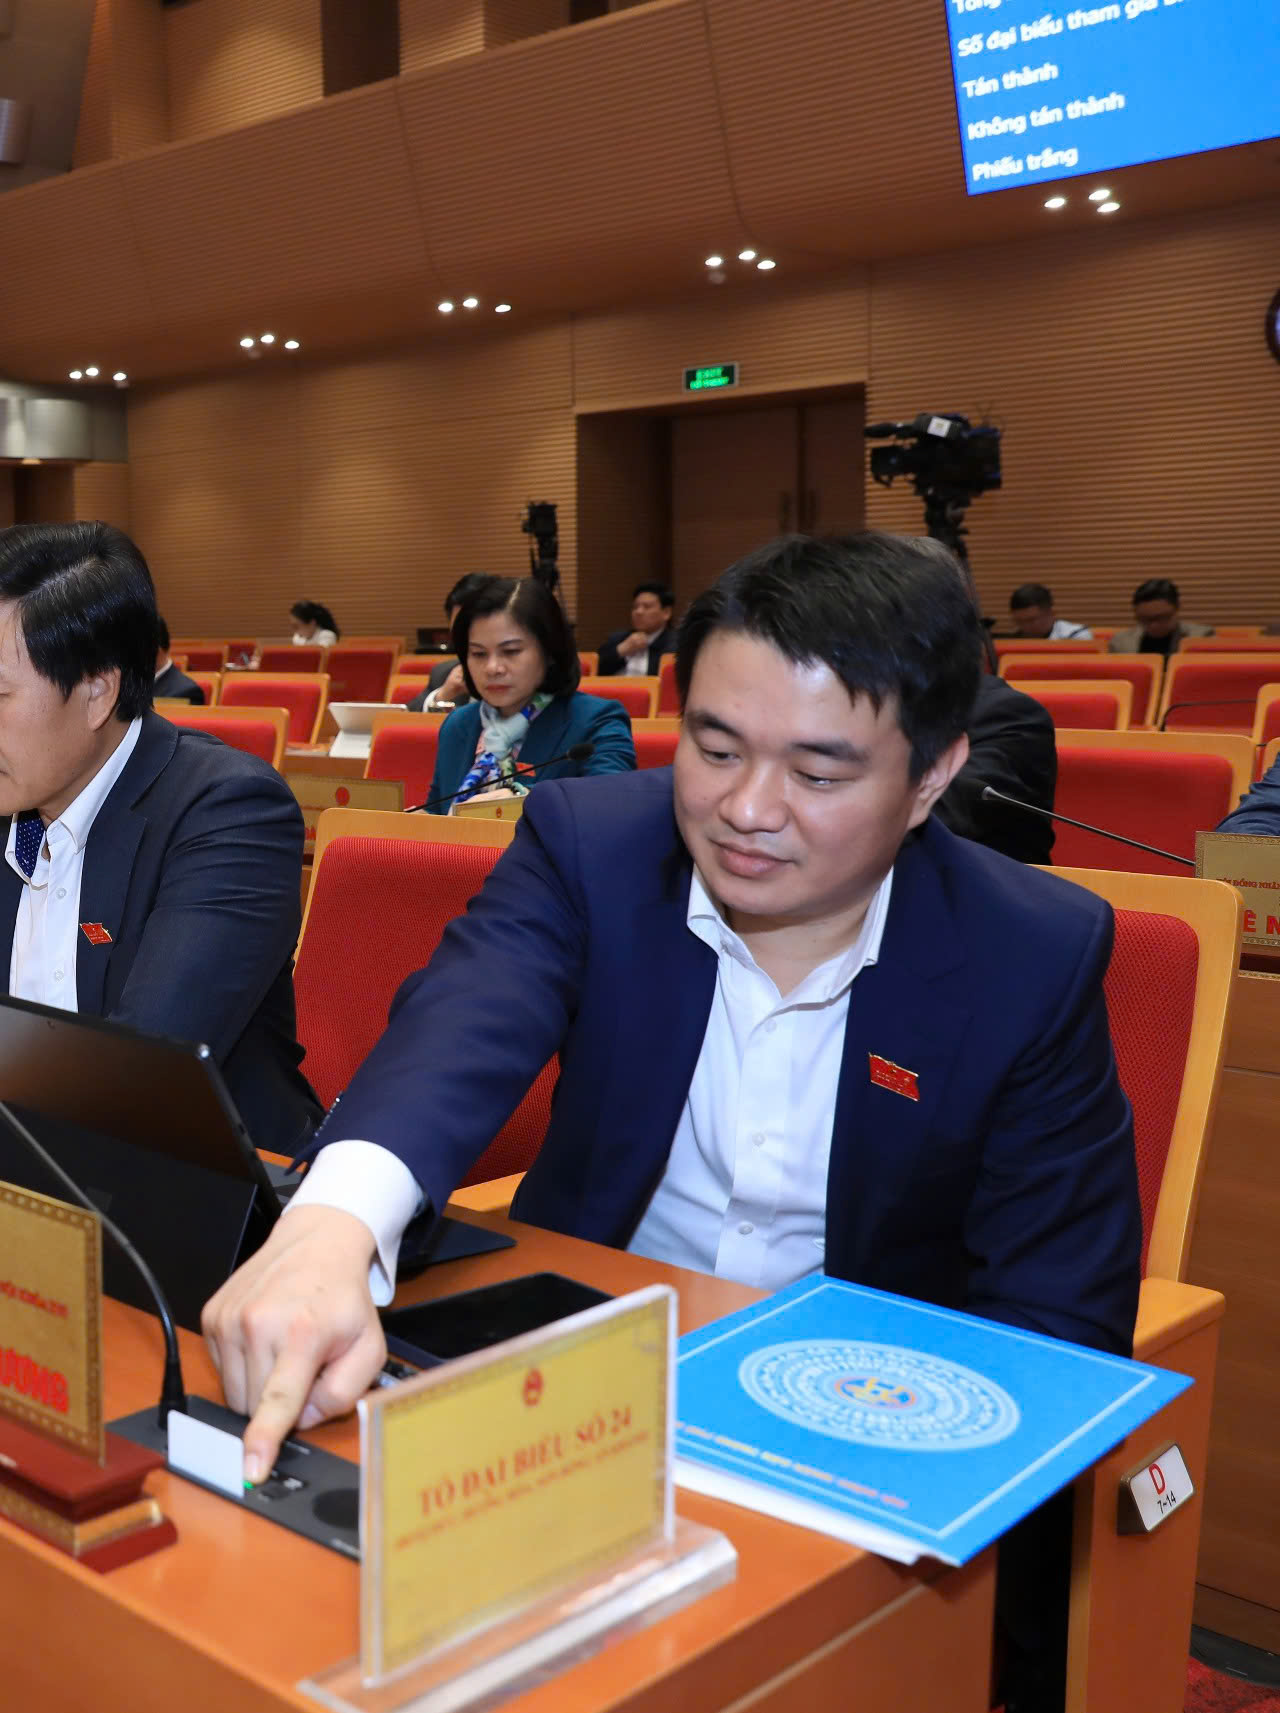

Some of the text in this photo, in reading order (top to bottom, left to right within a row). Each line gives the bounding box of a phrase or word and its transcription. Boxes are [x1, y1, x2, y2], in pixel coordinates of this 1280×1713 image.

[957, 33, 983, 57] Số
[986, 26, 1017, 50] đại
[1020, 14, 1063, 43] biểu
[1067, 3, 1120, 30] tham
[961, 62, 1059, 98] Tán thành
[968, 92, 1125, 140] Không tán thành
[972, 147, 1079, 182] Phiếu trắng
[1148, 1463, 1166, 1495] D
